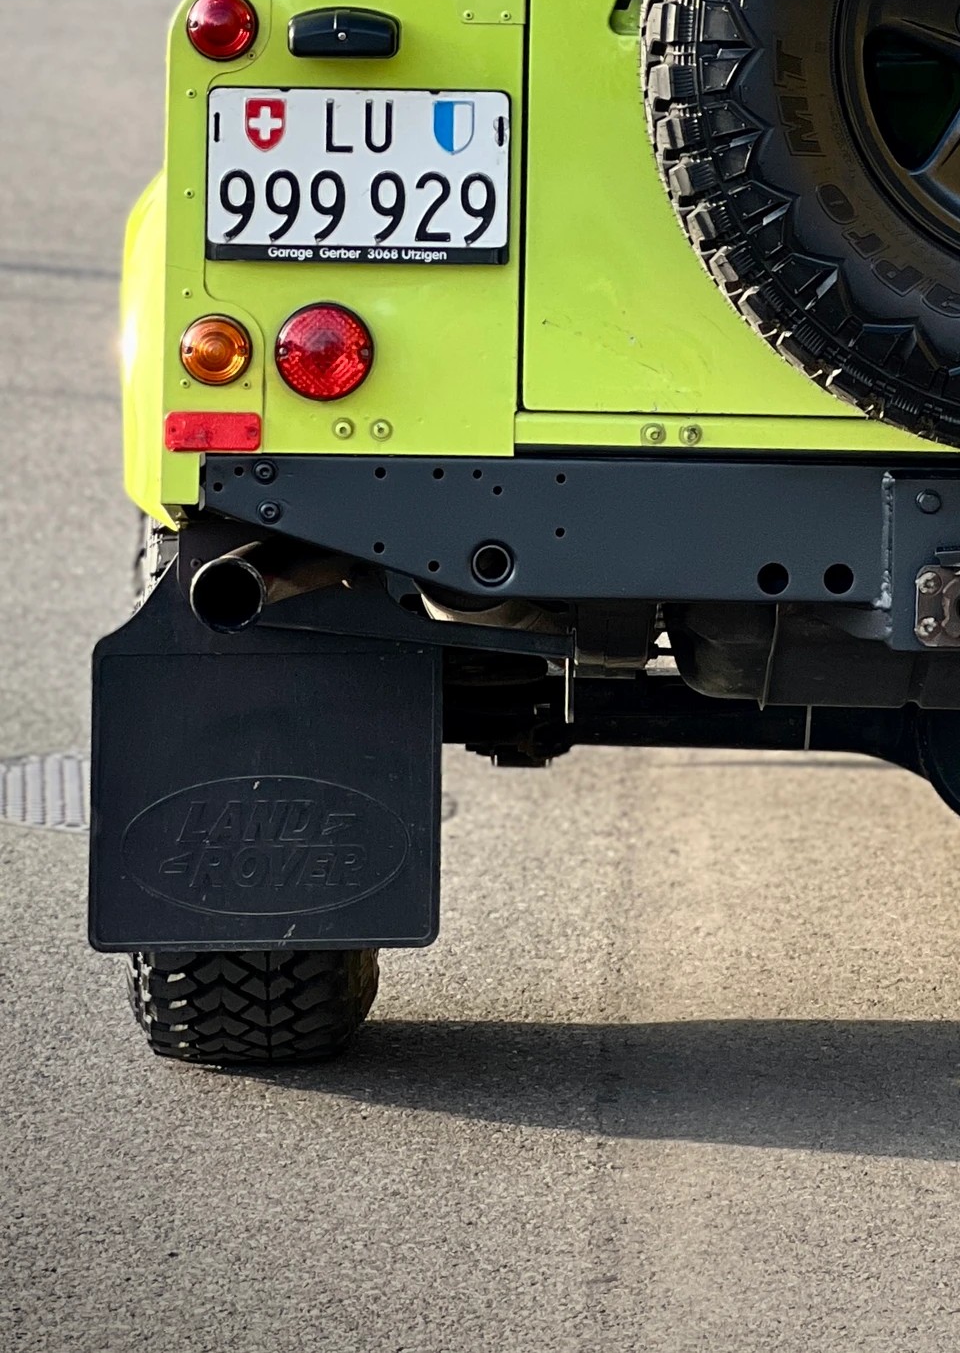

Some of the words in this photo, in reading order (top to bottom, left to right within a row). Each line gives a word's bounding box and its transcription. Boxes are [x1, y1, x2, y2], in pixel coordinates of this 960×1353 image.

[773, 39, 826, 157] MT
[326, 98, 394, 153] LU
[219, 168, 346, 243] 999
[370, 170, 497, 245] 929
[268, 247, 313, 260] Garage
[320, 247, 361, 259] Gerber
[367, 248, 399, 260] 3068
[401, 248, 447, 262] Utzigen
[176, 799, 315, 843] LAND
[188, 844, 367, 888] ROVER
